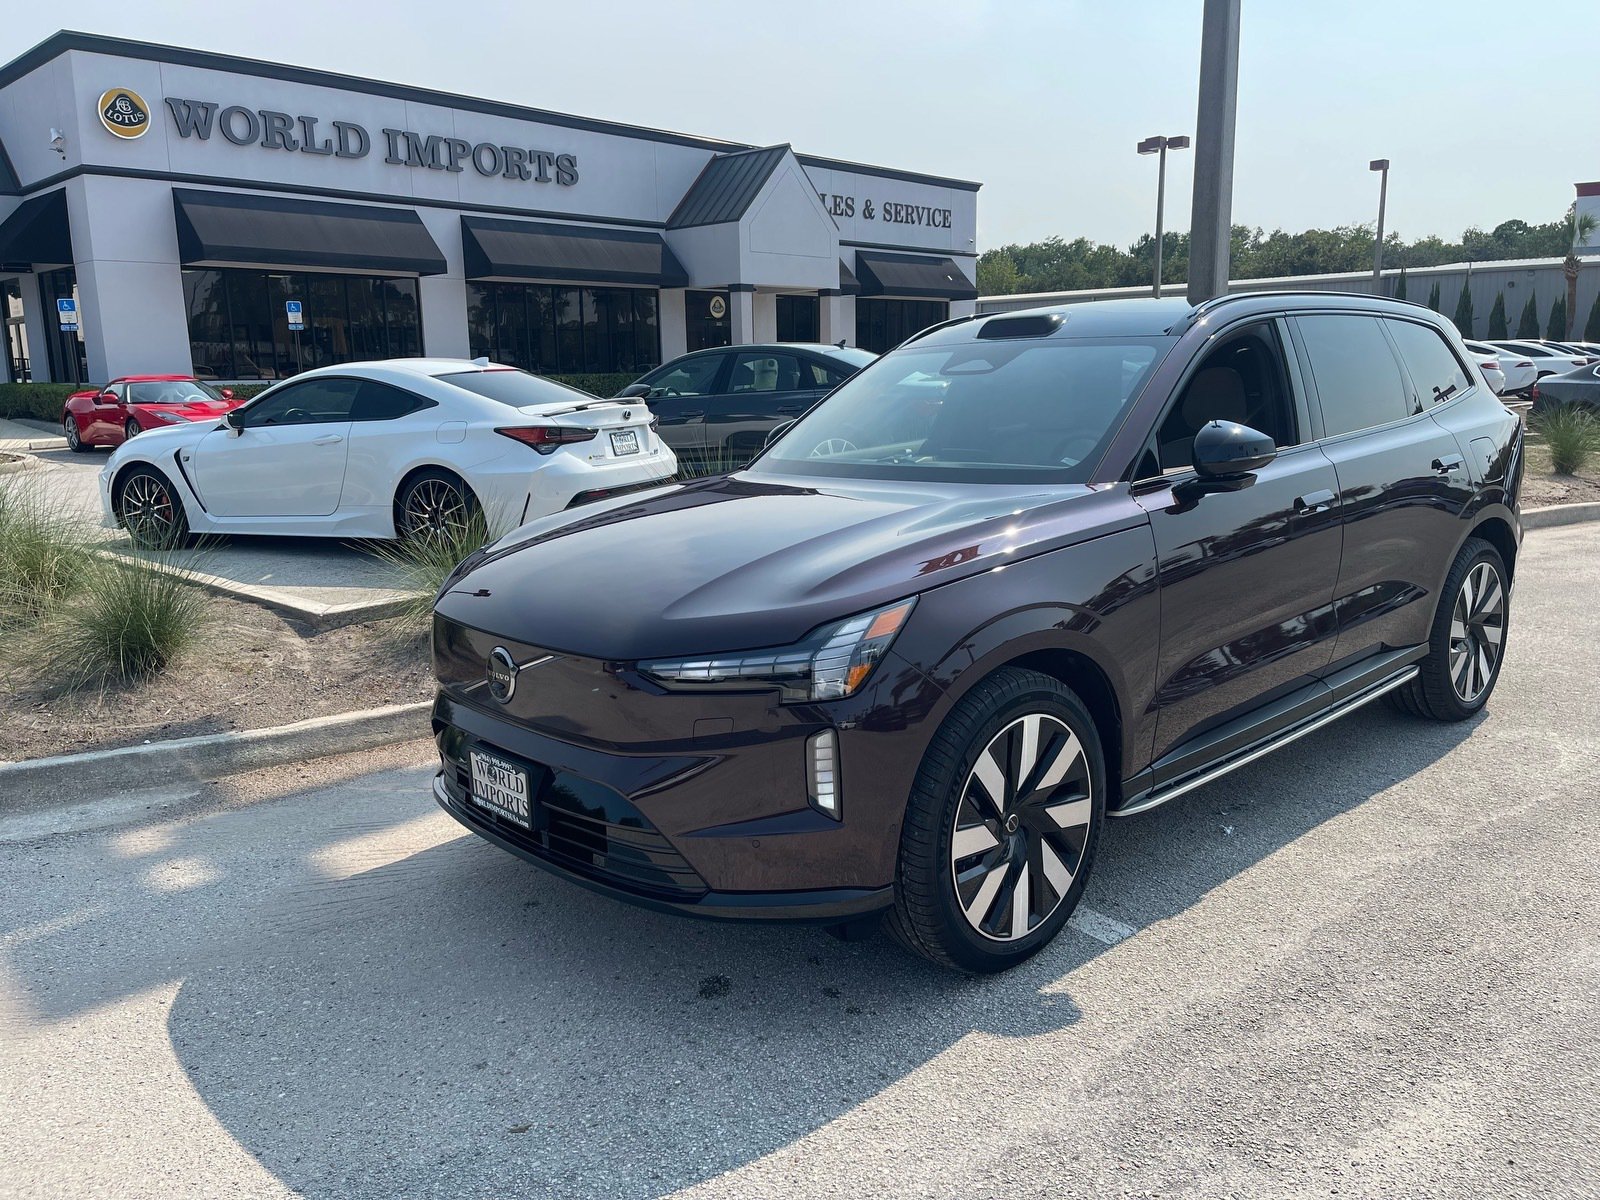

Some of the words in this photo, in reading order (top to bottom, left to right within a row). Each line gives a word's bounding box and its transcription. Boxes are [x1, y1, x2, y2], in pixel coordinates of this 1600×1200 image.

[106, 109, 145, 124] LOTUS
[165, 97, 371, 159] WORLD
[382, 128, 579, 186] IMPORTS
[862, 199, 875, 220] &
[883, 201, 952, 229] SERVICE
[613, 434, 635, 443] WORLD
[614, 442, 638, 451] IMPORTS
[487, 669, 510, 682] VOLVO
[473, 778, 529, 818] IMPORTS
